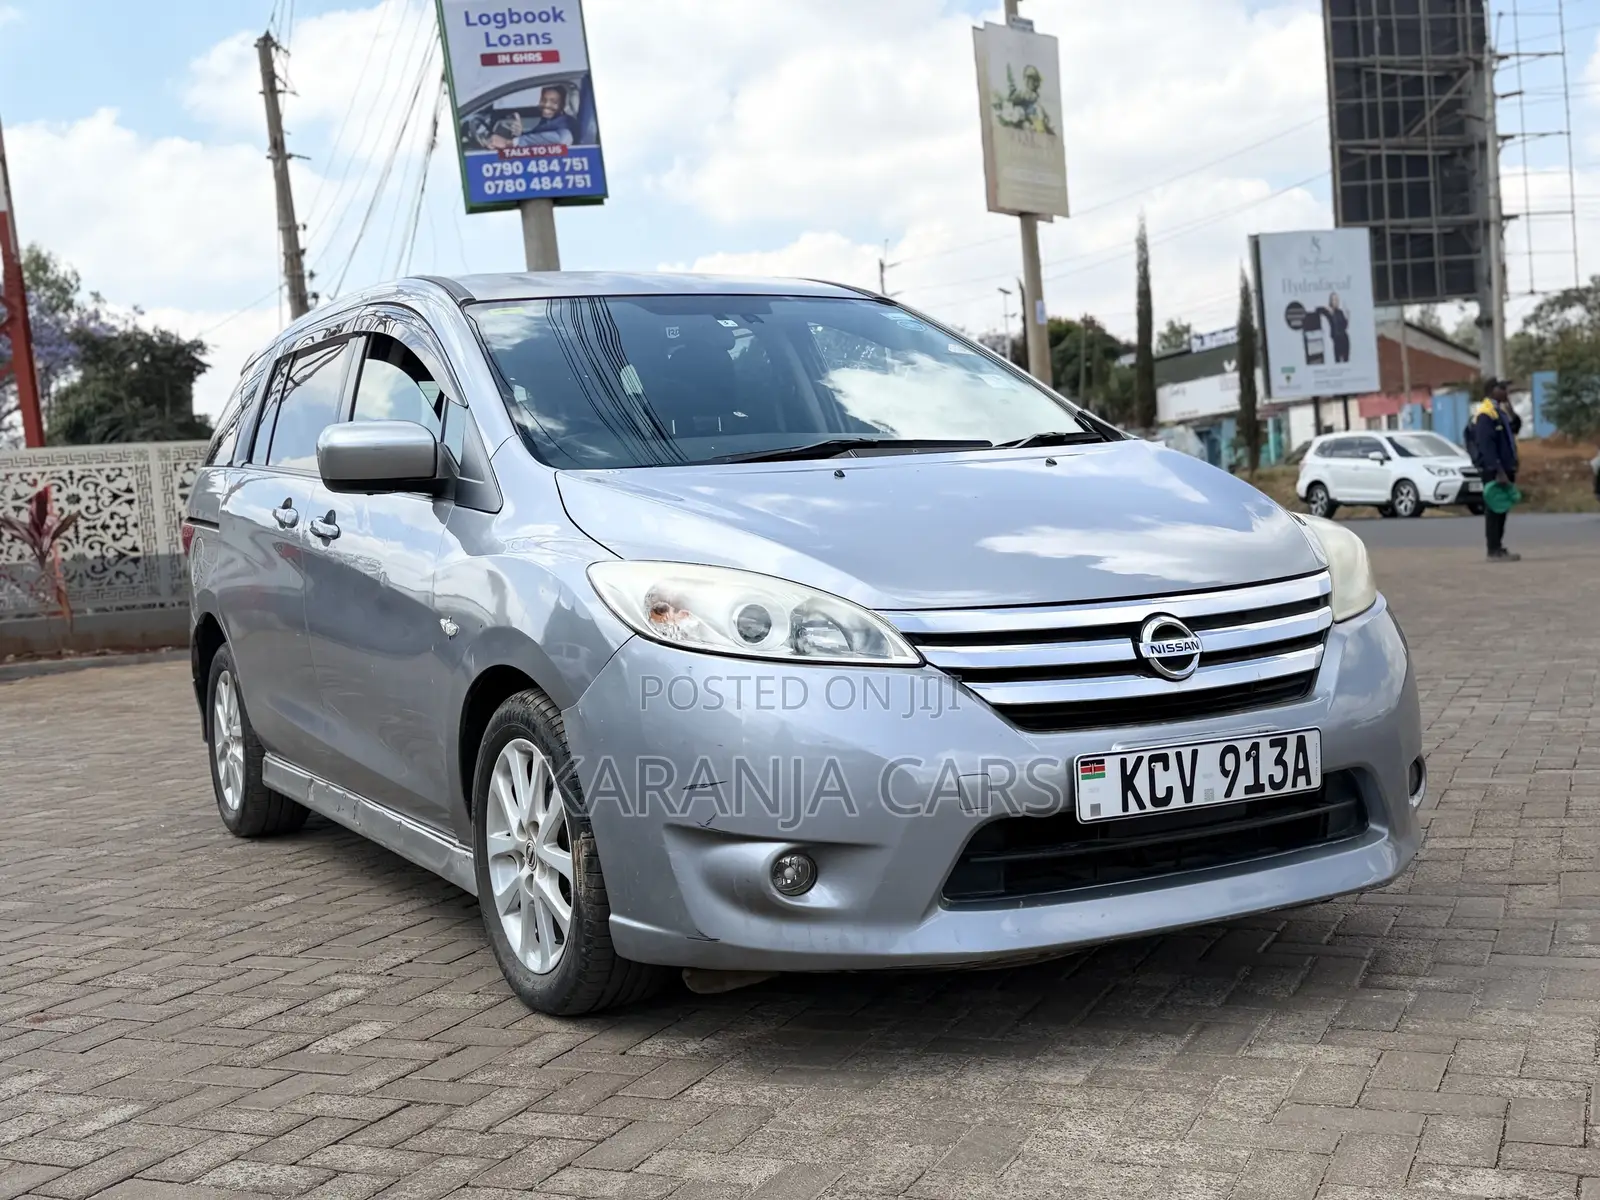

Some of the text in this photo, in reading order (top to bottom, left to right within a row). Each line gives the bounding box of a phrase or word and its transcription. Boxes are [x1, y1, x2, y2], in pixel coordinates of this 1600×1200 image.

[464, 6, 566, 29] Logbook
[484, 31, 553, 48] Loans
[497, 52, 543, 64] IN 6HRS
[503, 145, 562, 158] TALK TO US
[481, 157, 589, 178] 0790 484 751
[484, 173, 592, 195] 0780 484 751
[1150, 641, 1200, 655] NISSAN
[1120, 748, 1199, 813] KCV
[1218, 734, 1312, 799] 913A
